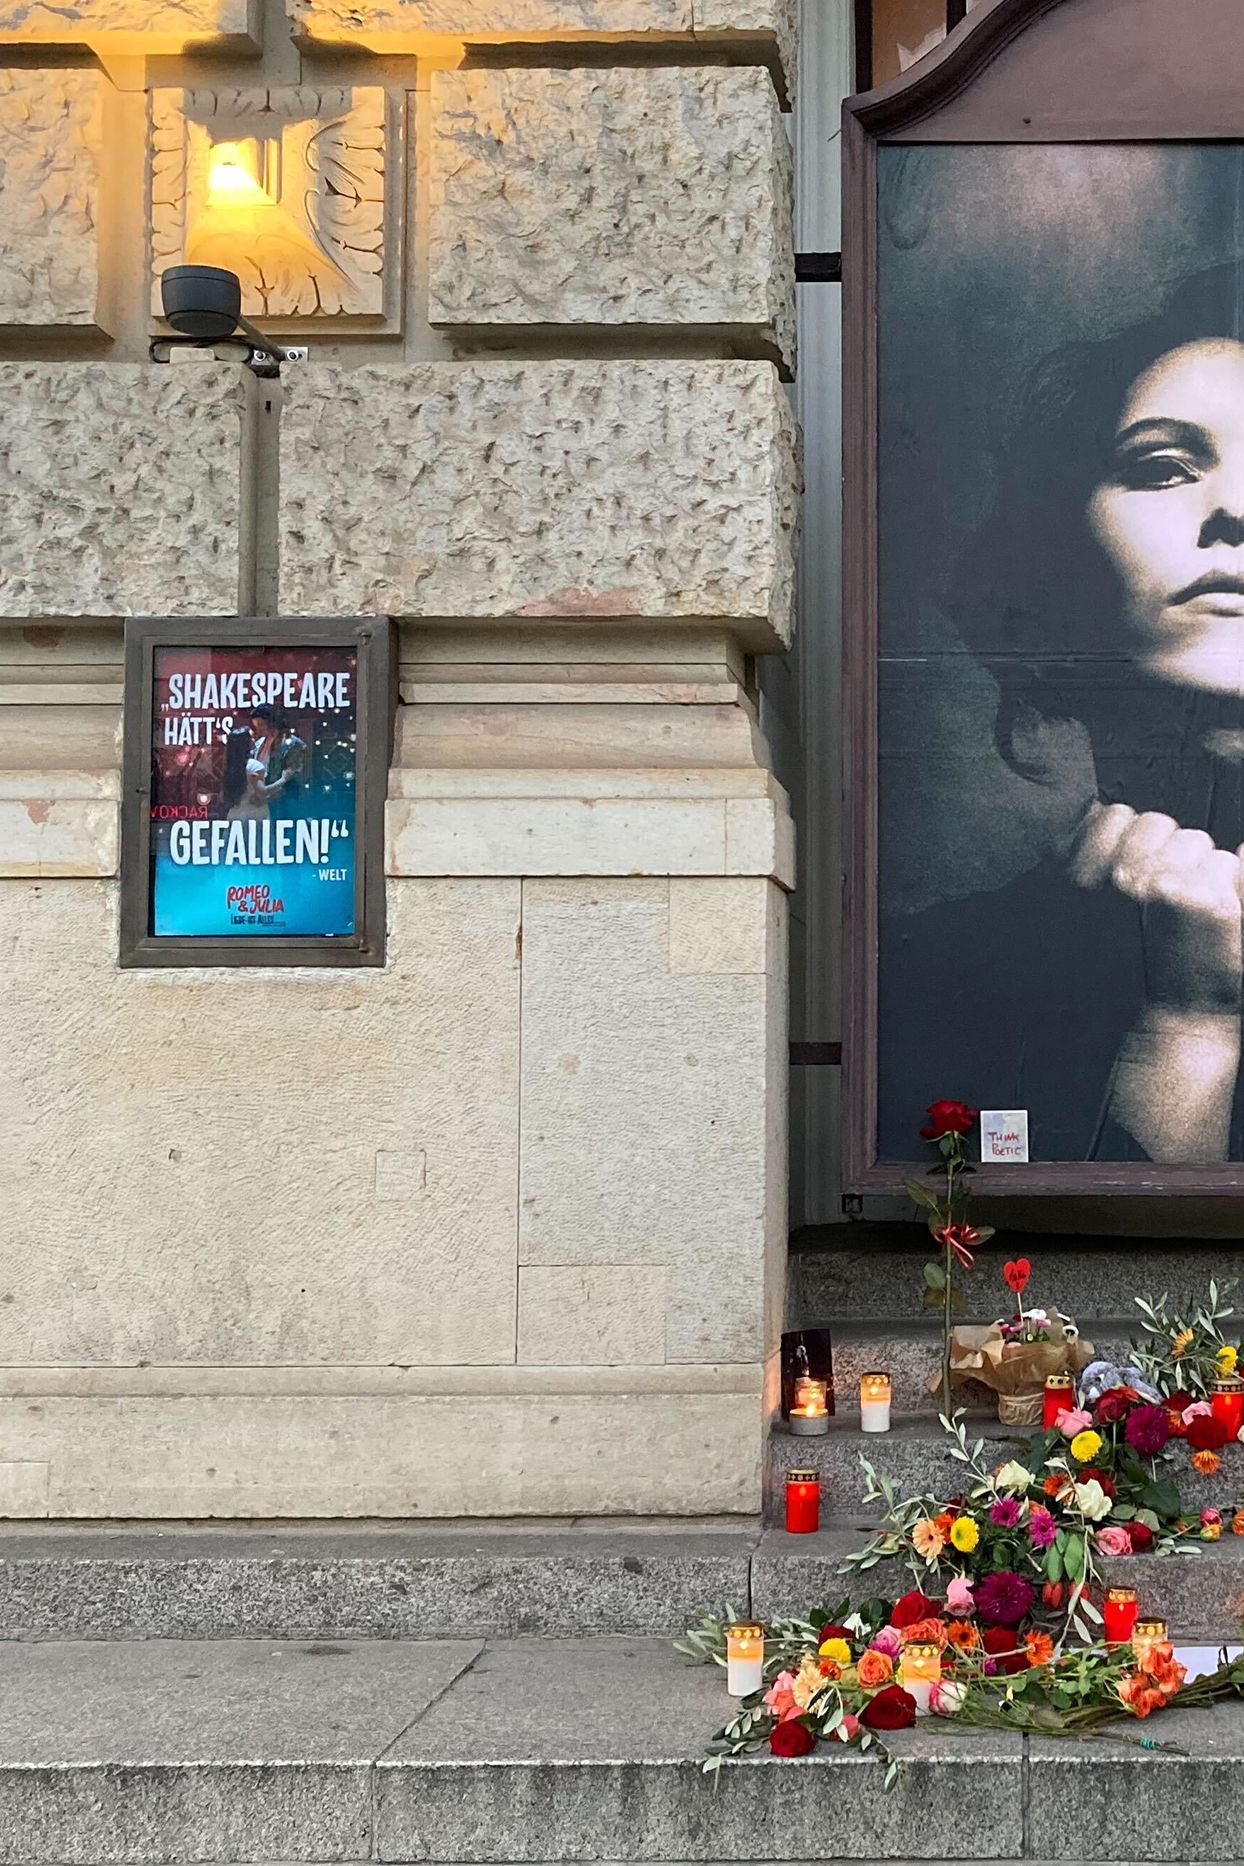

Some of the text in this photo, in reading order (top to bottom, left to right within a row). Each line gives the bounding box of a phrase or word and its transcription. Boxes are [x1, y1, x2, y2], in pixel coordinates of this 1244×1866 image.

[318, 868, 347, 881] WELT
[227, 884, 270, 909] ROMEO
[238, 899, 284, 914] & JULIA
